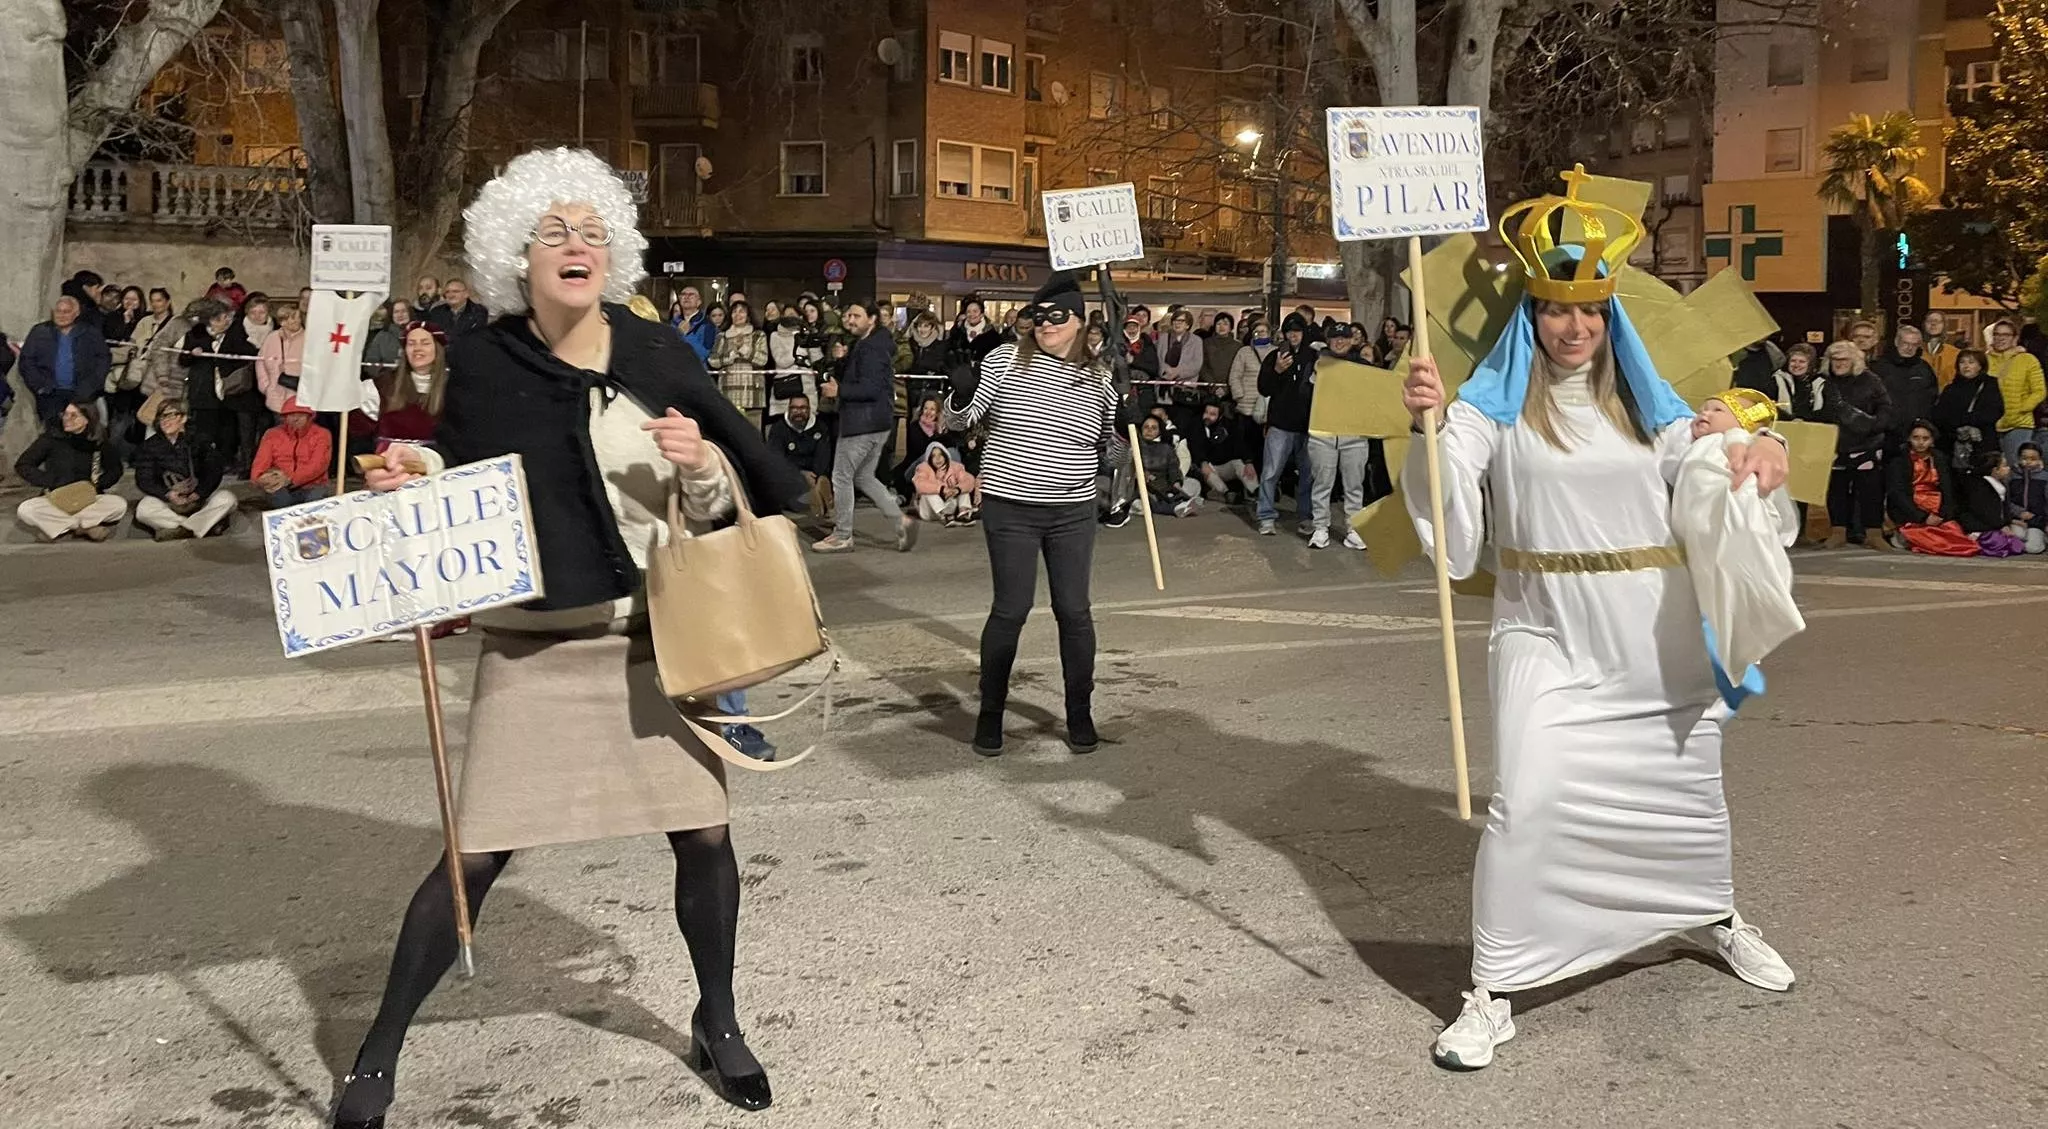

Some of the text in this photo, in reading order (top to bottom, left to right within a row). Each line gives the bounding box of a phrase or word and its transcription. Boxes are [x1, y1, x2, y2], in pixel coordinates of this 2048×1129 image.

[1374, 131, 1470, 155] AVENIDA
[1076, 196, 1126, 218] CALLE
[1356, 179, 1470, 216] PILAR
[964, 262, 1028, 281] PISCIS
[343, 484, 503, 552] CALLE
[316, 539, 503, 616] MAYOR
